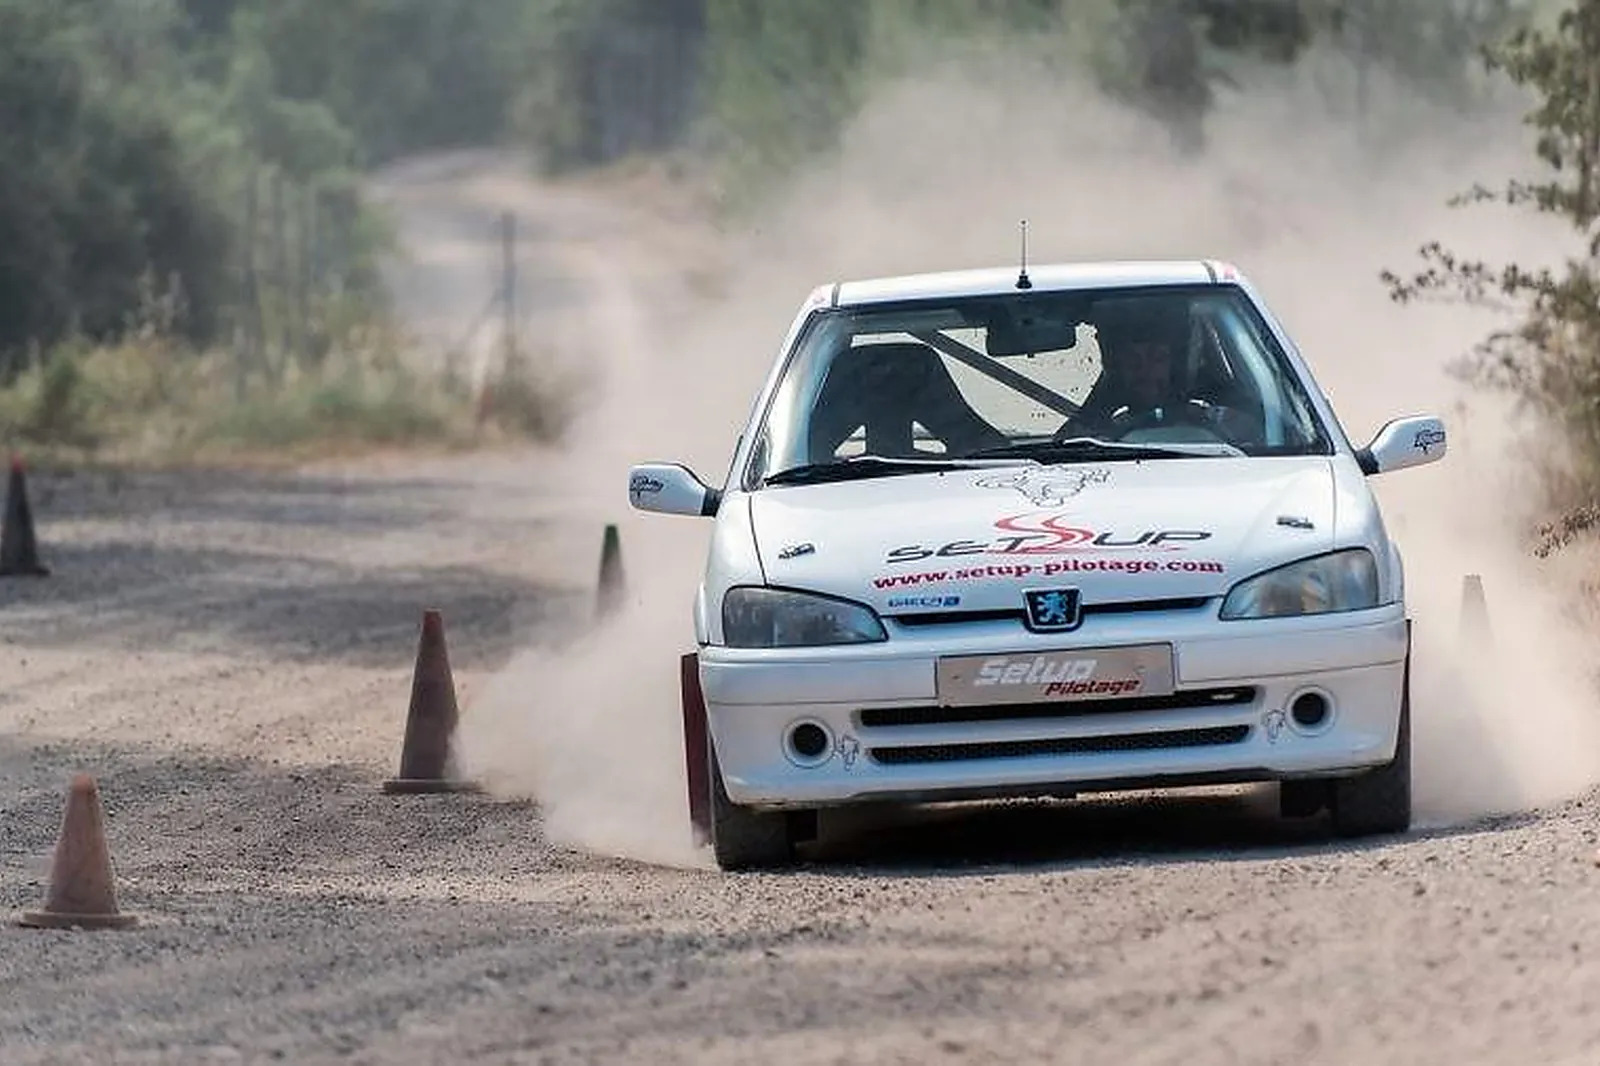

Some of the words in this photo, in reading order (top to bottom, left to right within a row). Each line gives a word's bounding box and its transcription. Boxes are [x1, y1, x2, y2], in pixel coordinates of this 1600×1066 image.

[873, 559, 1225, 589] www.setup-pilotage.com
[973, 656, 1098, 687] Setup
[1044, 679, 1140, 696] Pilotage
